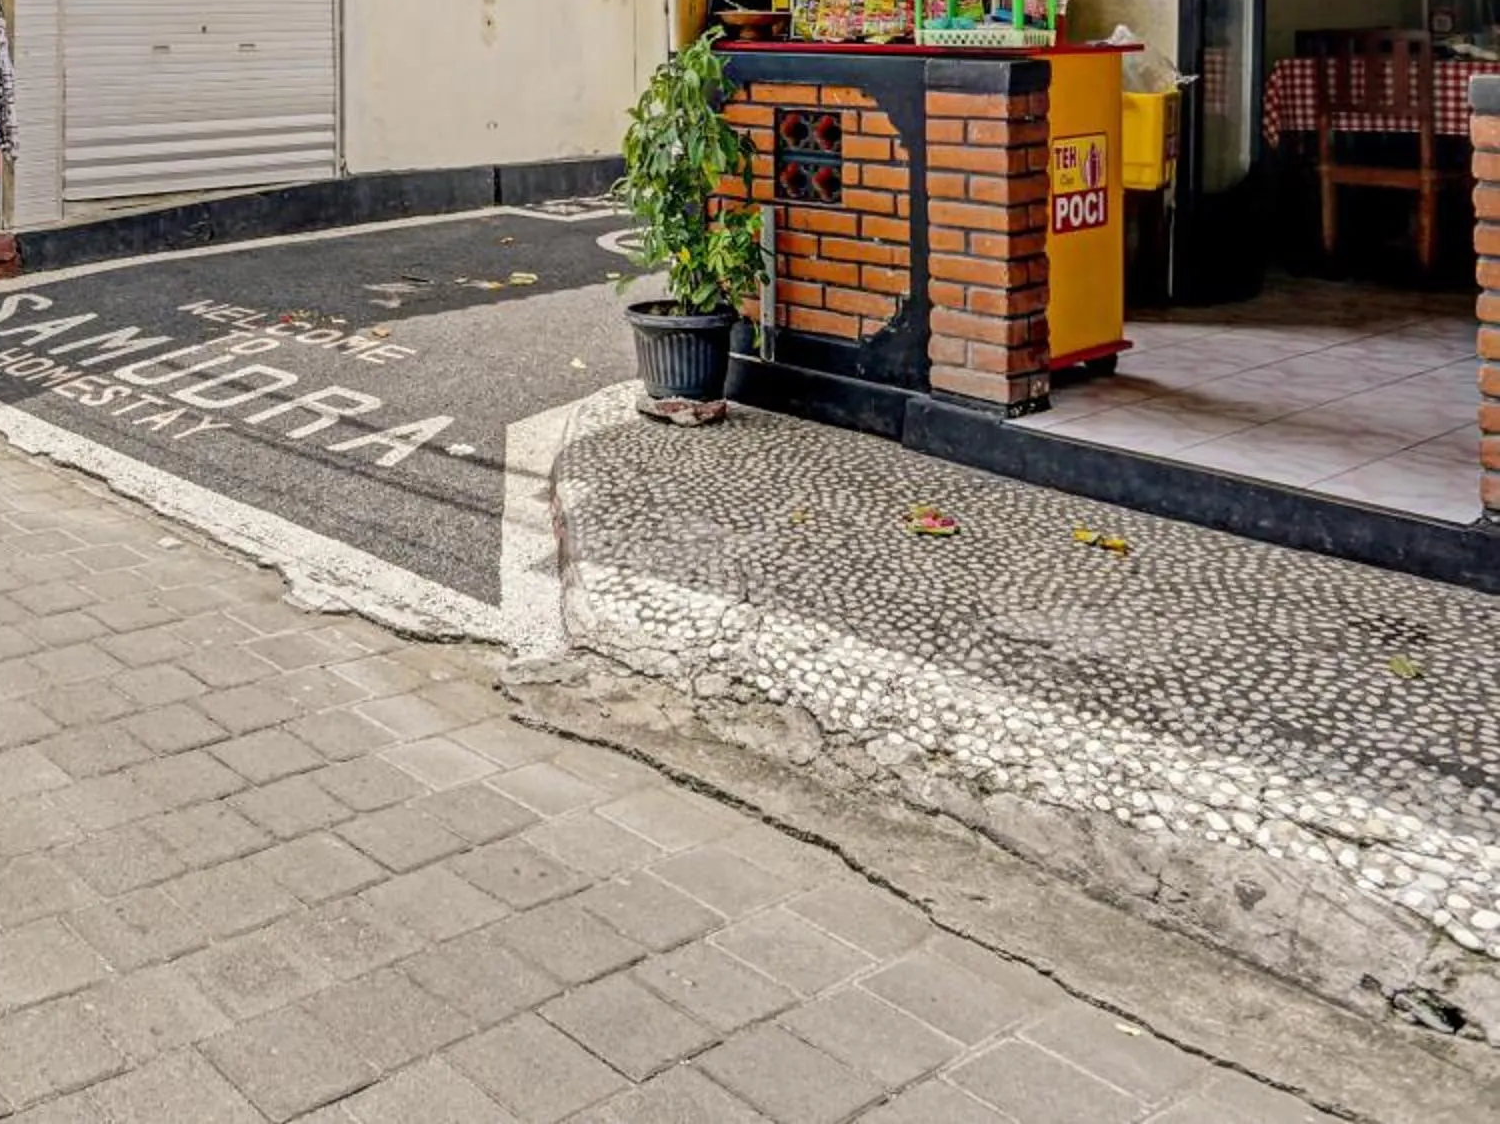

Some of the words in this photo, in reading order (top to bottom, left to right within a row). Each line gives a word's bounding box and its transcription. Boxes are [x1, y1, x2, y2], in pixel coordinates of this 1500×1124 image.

[1053, 146, 1077, 170] TEH
[1055, 190, 1105, 230] POCI
[178, 299, 417, 364] WELCOME
[207, 327, 280, 356] TO
